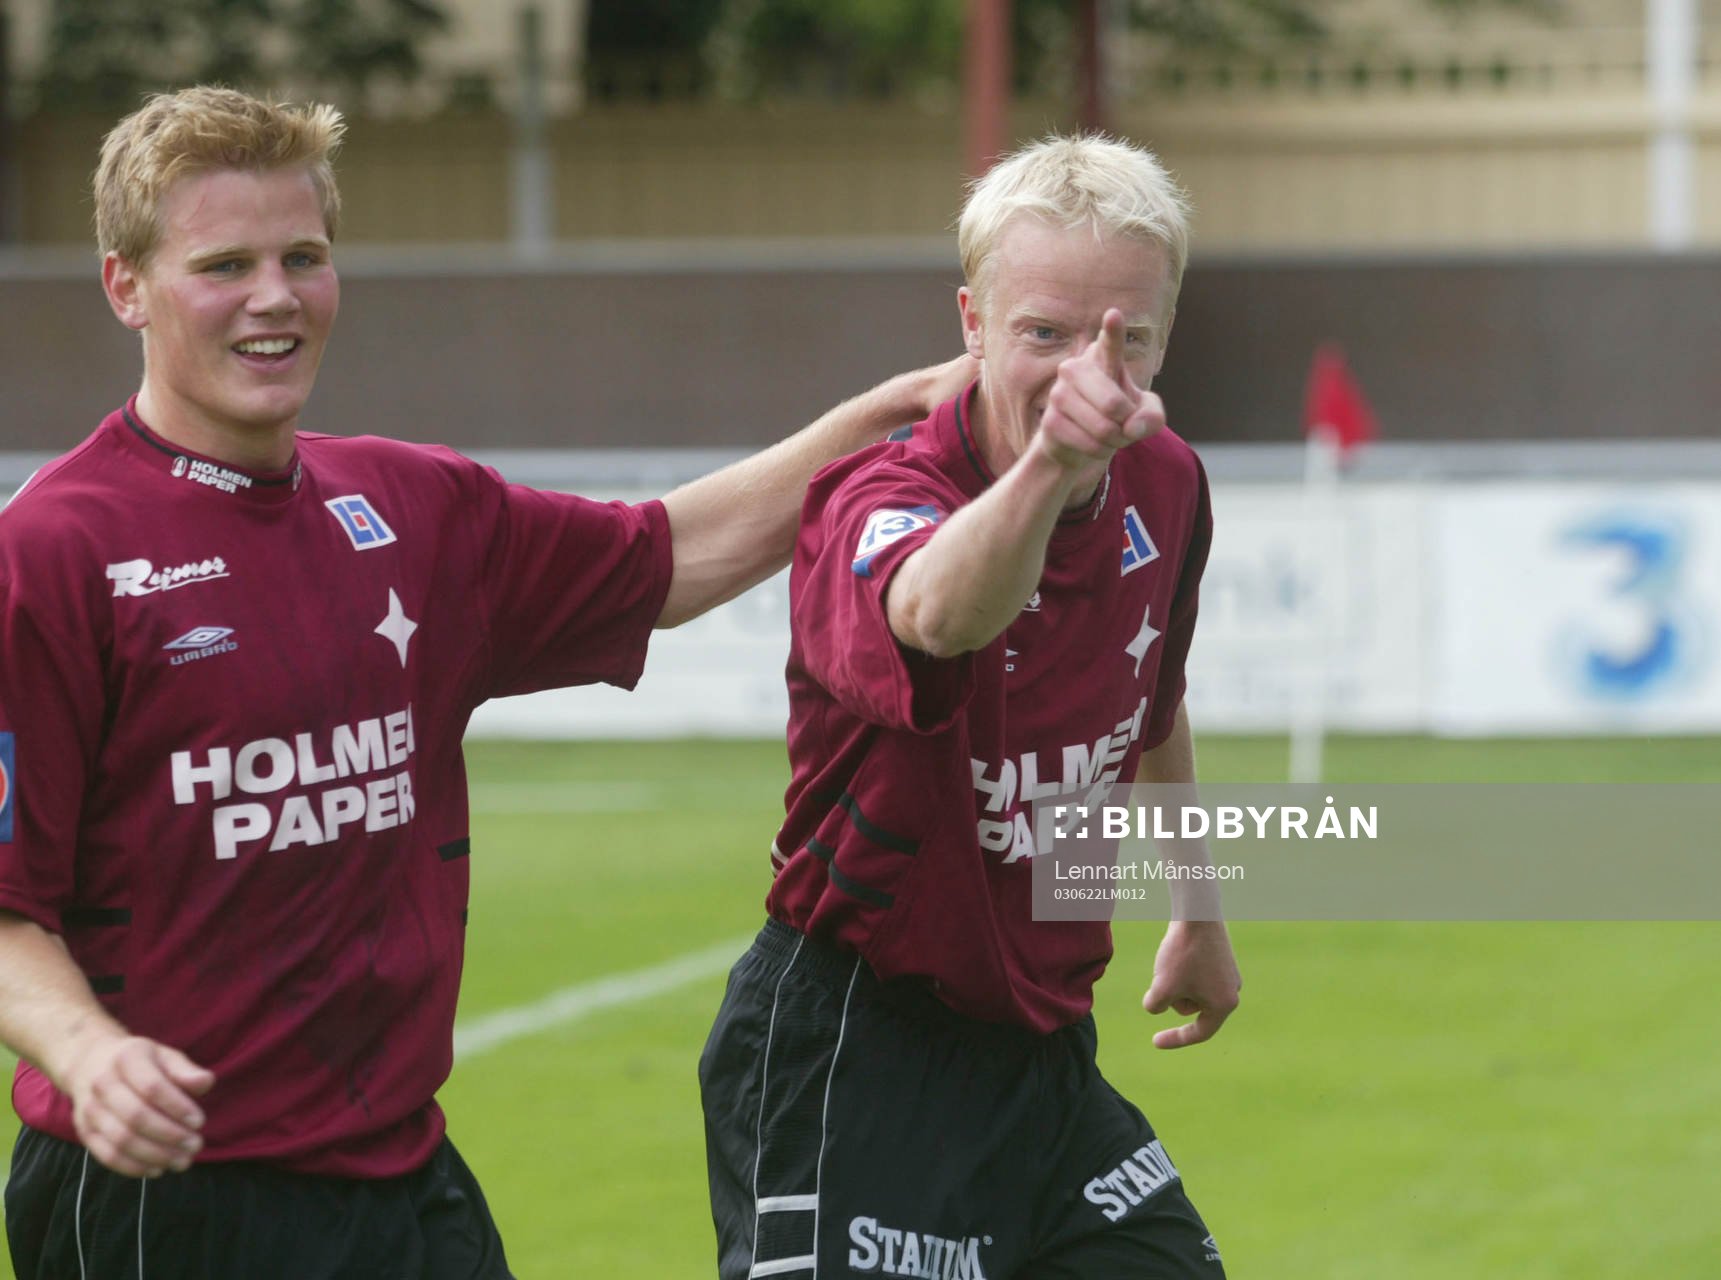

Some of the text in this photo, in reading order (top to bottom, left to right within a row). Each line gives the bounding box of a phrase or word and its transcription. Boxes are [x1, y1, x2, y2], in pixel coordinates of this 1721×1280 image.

[187, 470, 237, 494] PAPER
[190, 460, 253, 488] HOLMEN
[213, 771, 415, 860] PAPER
